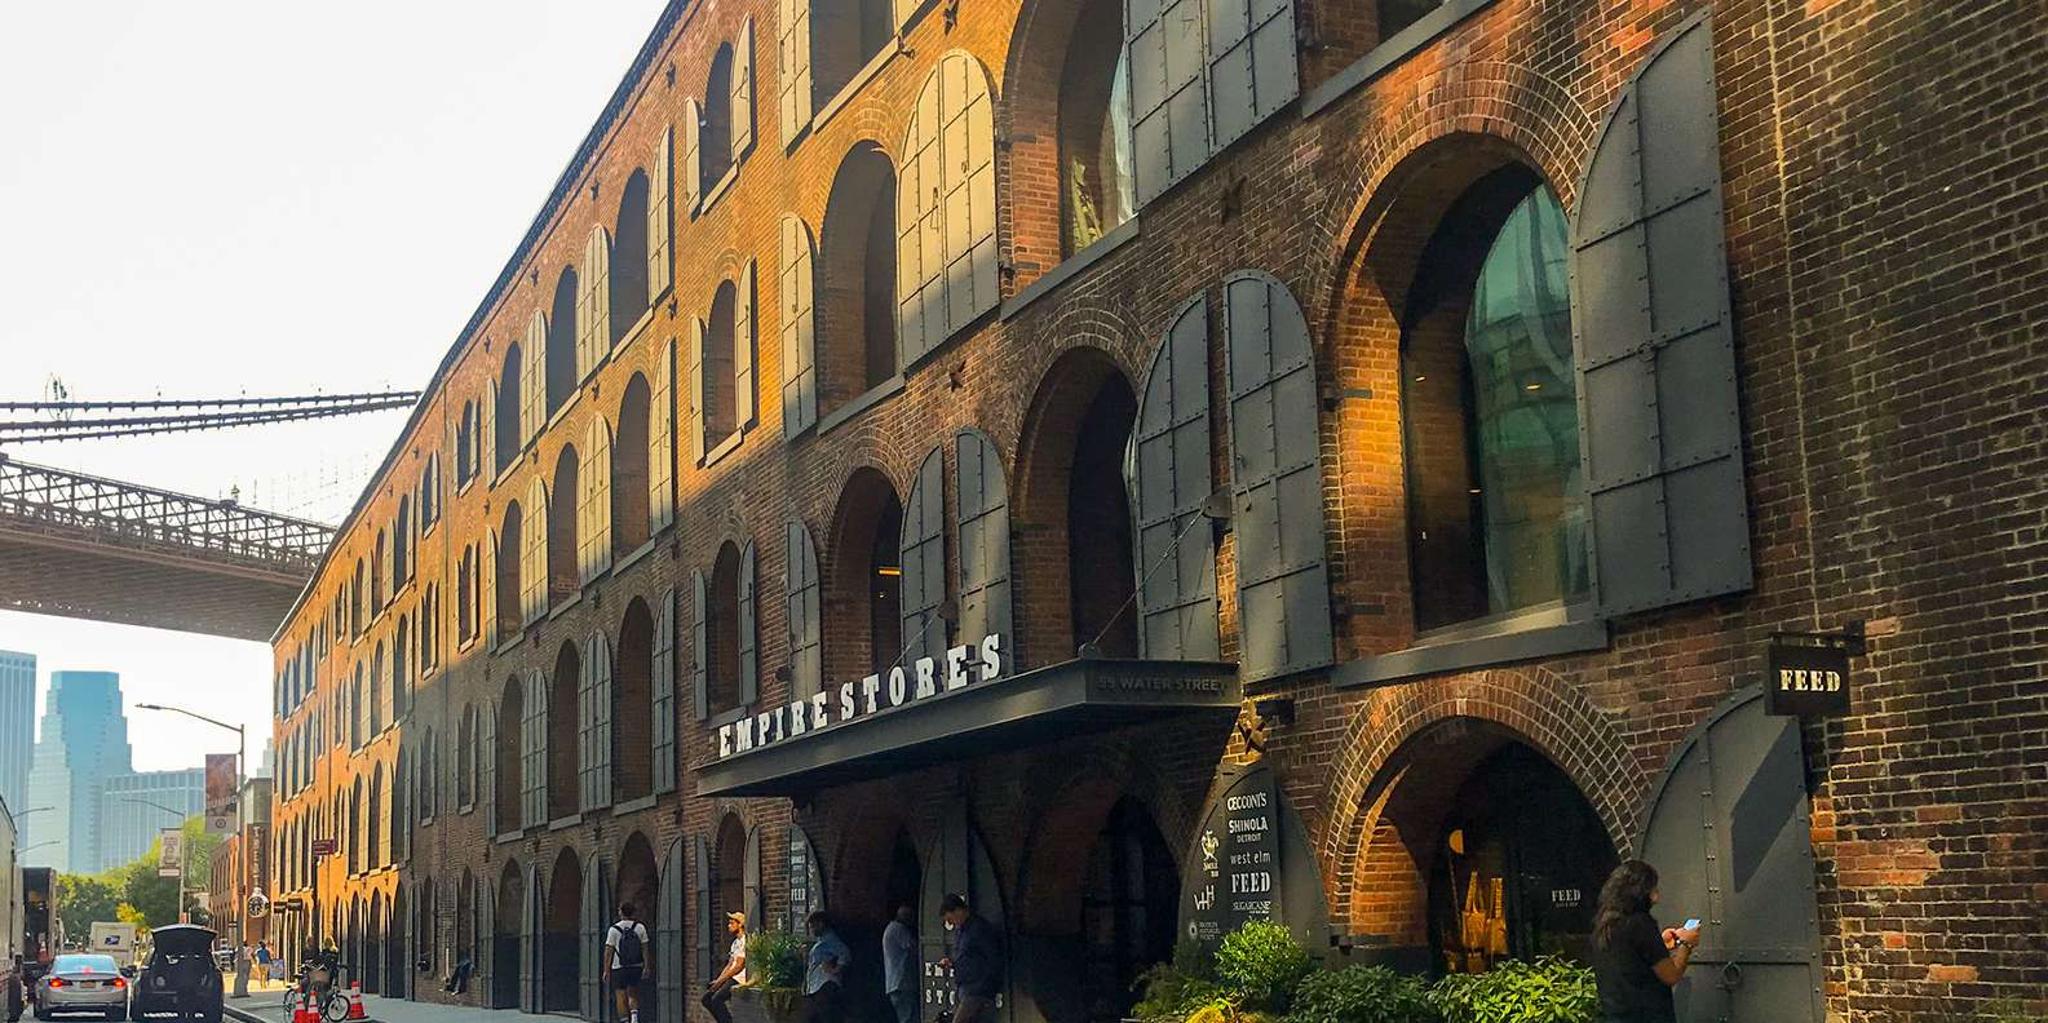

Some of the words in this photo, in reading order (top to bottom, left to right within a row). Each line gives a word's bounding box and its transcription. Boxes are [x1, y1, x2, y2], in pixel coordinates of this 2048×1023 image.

[1119, 676, 1170, 690] WATER
[1175, 678, 1226, 691] STREET
[1779, 669, 1841, 692] FEED
[719, 691, 828, 758] EMPIRE
[840, 633, 1001, 720] STORES
[1228, 816, 1268, 834] SHINOLA
[1236, 833, 1262, 843] DETROIT
[1230, 852, 1252, 865] west
[1254, 850, 1271, 864] elm
[1231, 872, 1271, 893] FEED
[1552, 889, 1581, 901] FEED
